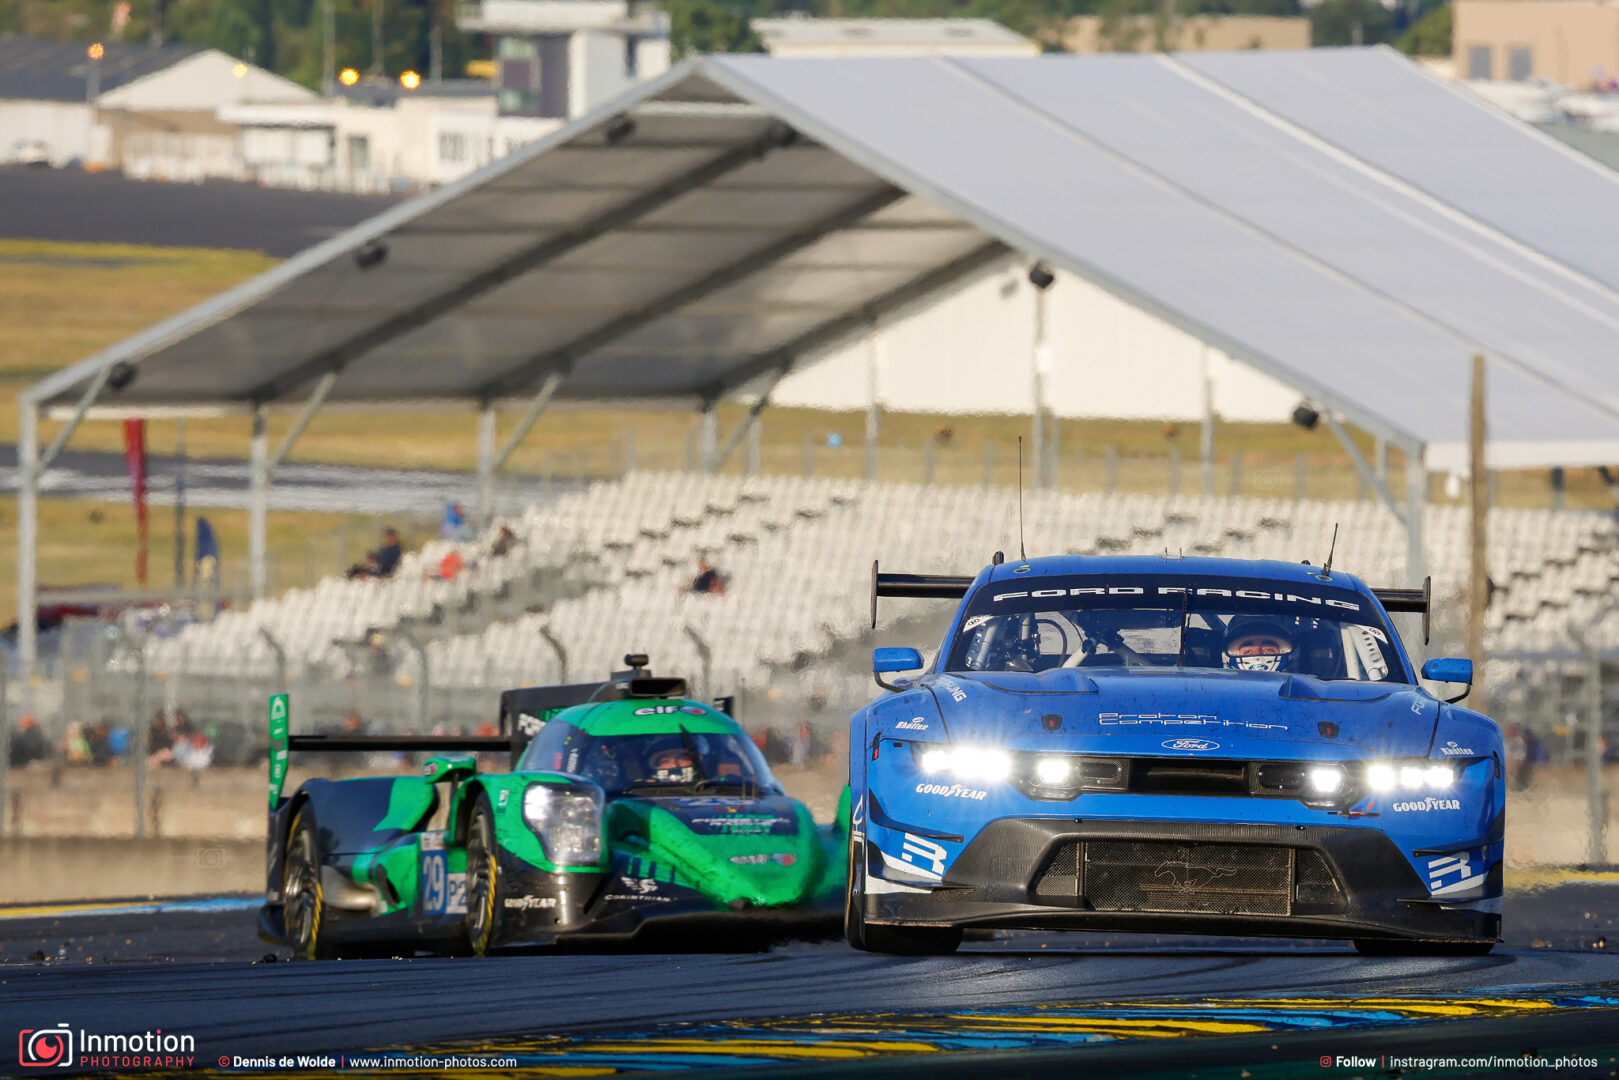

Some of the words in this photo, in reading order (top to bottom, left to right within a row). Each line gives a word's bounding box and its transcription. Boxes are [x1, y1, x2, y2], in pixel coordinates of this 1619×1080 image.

[993, 587, 1145, 602] FORD
[1157, 586, 1360, 612] RACING
[1098, 712, 1217, 720] Proton
[1099, 718, 1289, 731] Competition
[1172, 739, 1209, 750] Ford
[915, 782, 988, 801] GOODYEAR
[1392, 796, 1461, 813] GOODYEAR
[422, 854, 446, 912] 29
